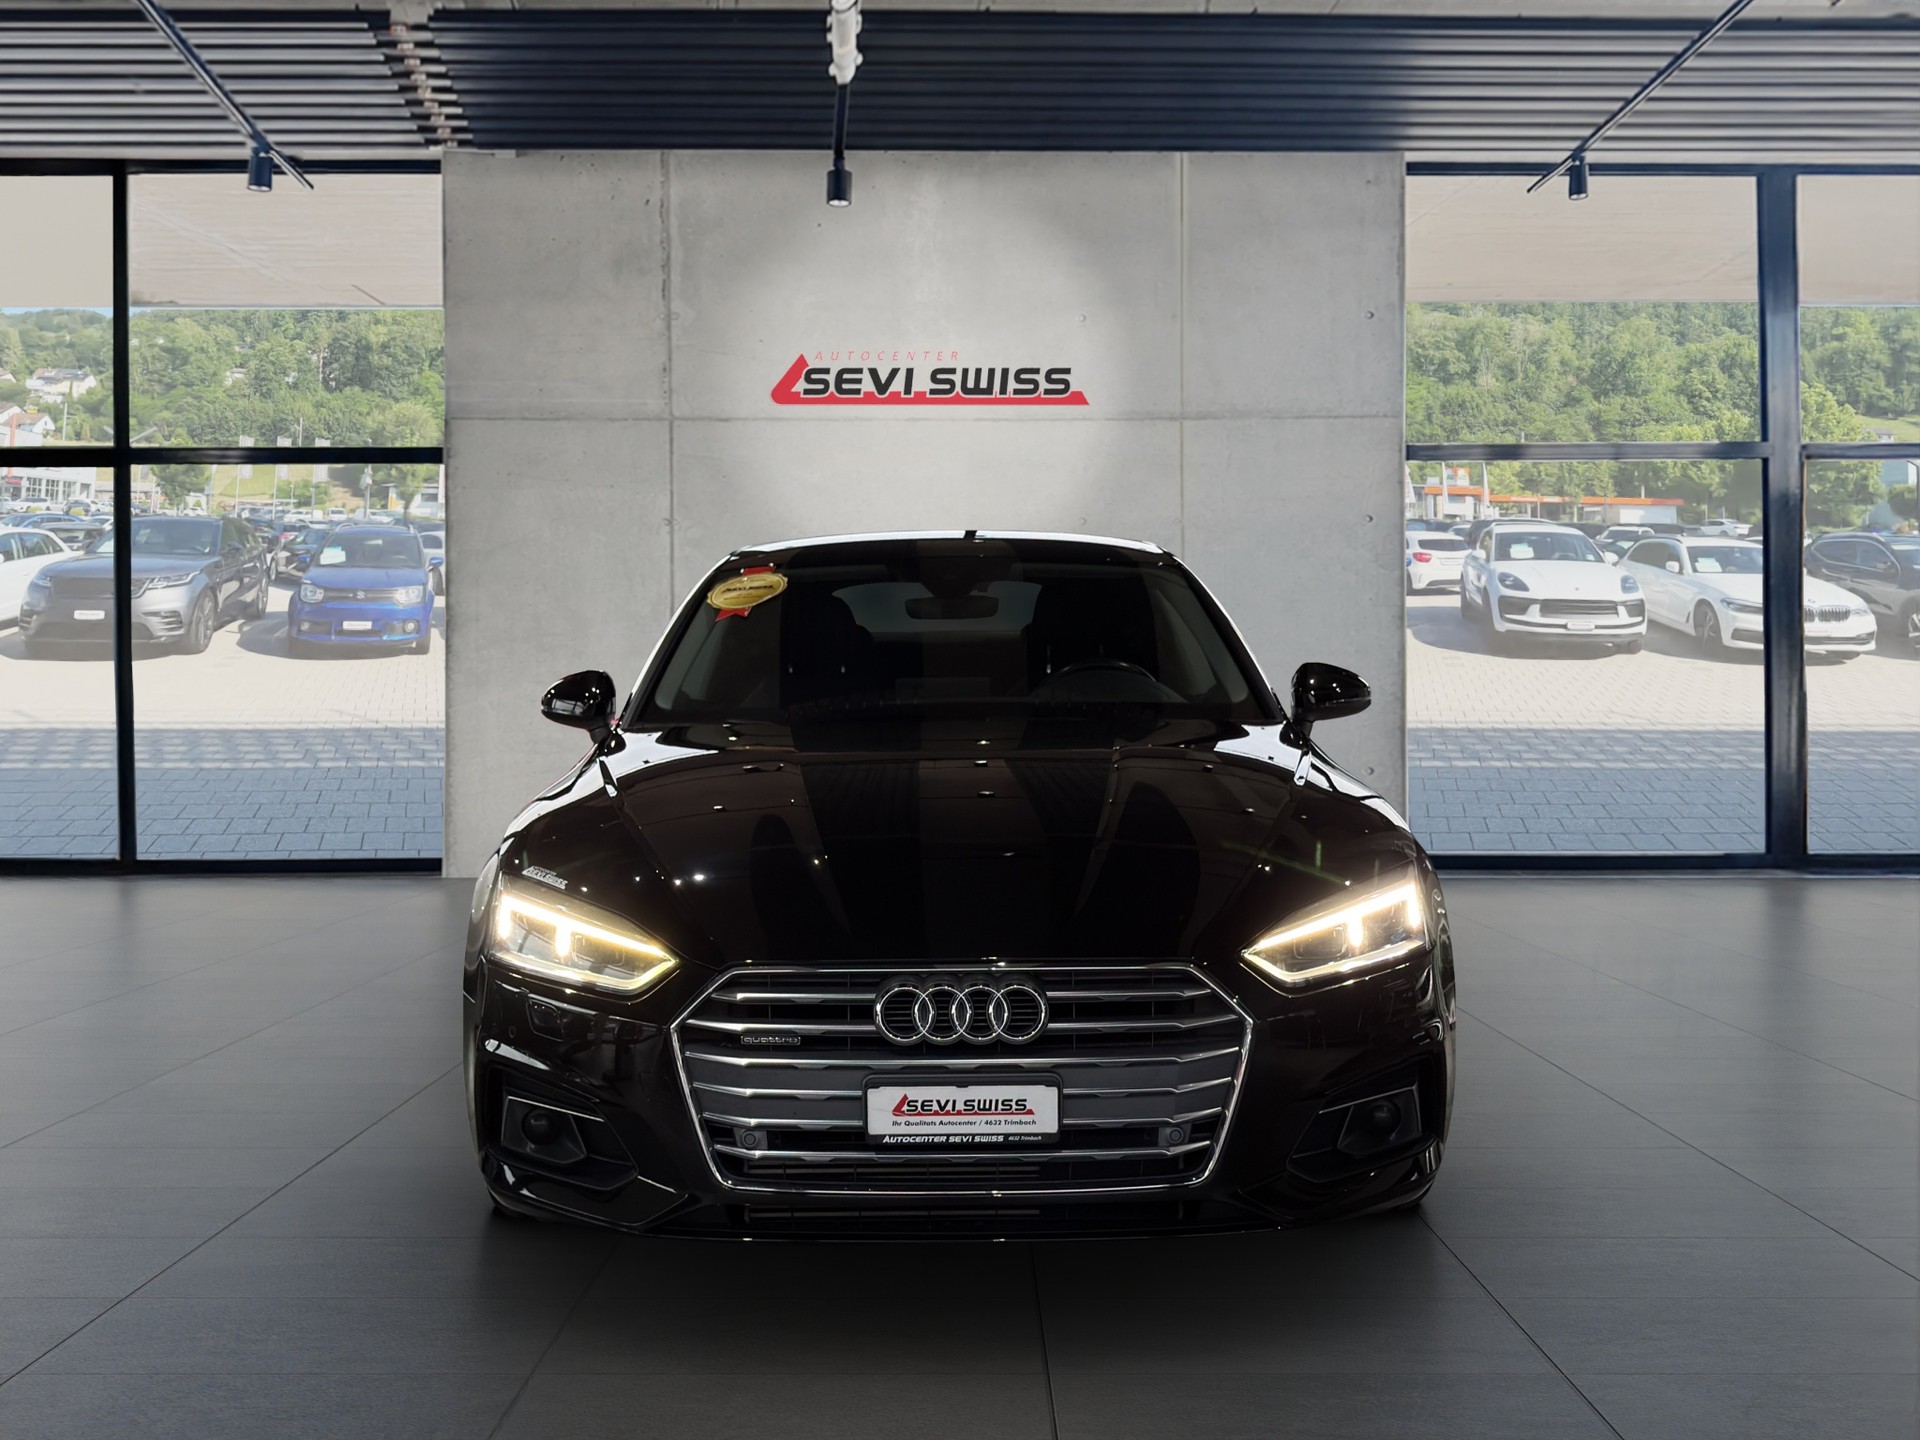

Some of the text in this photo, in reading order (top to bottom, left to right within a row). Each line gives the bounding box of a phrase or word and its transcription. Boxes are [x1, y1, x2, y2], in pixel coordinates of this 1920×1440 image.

[813, 350, 960, 362] AUTOCENTER
[802, 367, 1072, 396] SEVI SWISS
[743, 1036, 798, 1044] quattro
[906, 1098, 1028, 1113] SEVI SWISS
[949, 1135, 973, 1143] SEVI
[973, 1134, 1005, 1143] SWISS
